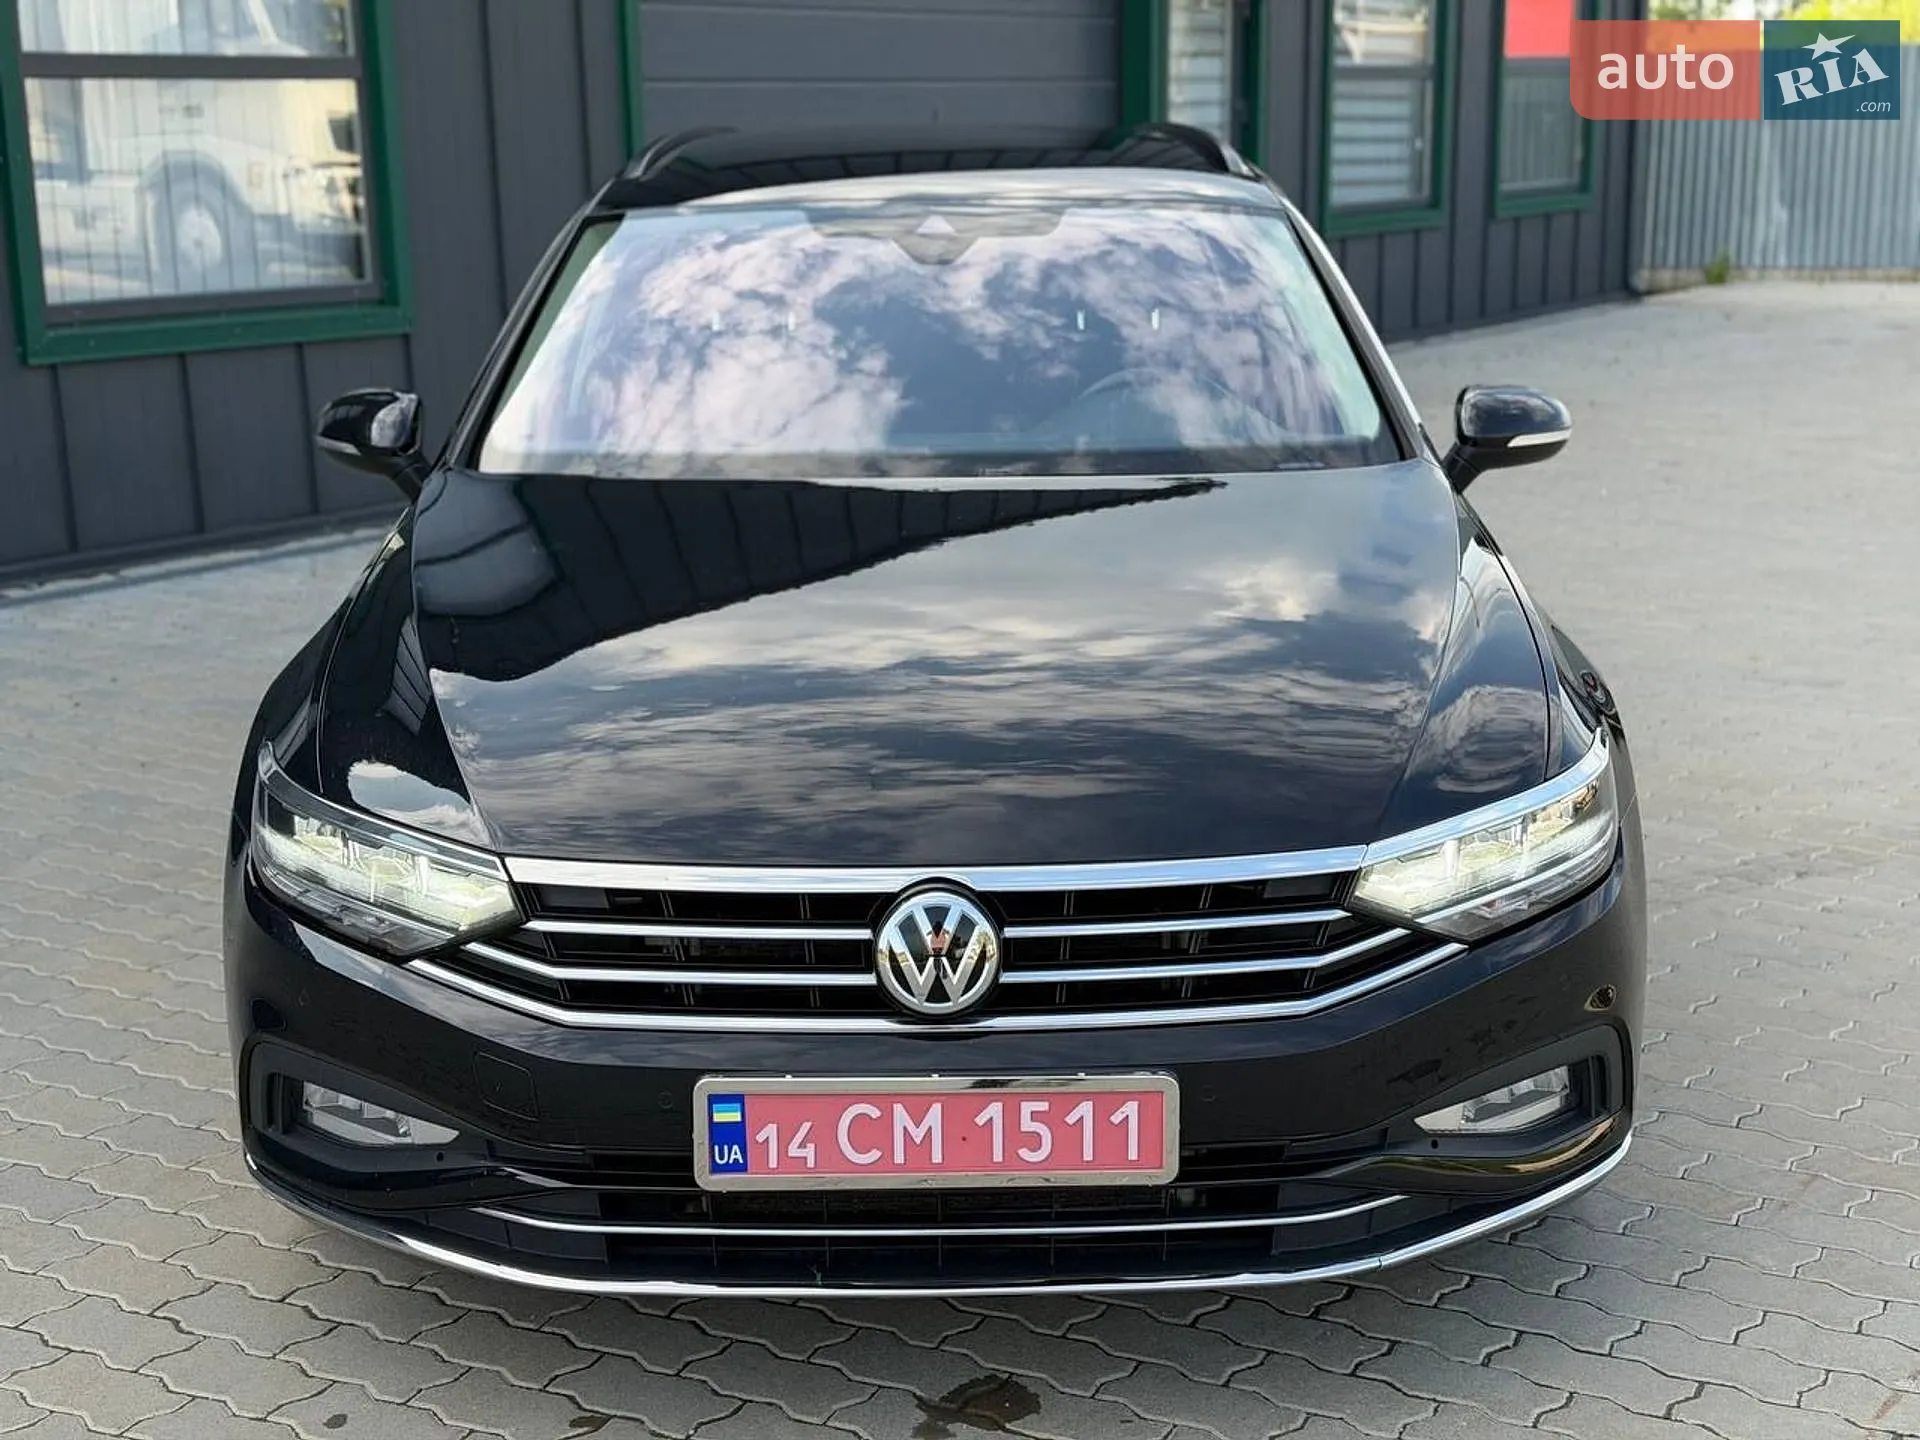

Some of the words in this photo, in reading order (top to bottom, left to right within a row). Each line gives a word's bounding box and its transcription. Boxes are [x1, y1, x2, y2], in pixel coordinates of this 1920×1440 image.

[714, 1142, 744, 1165] UA
[756, 1121, 815, 1168] 14
[836, 1102, 943, 1165] CM
[974, 1100, 1140, 1163] 1511
